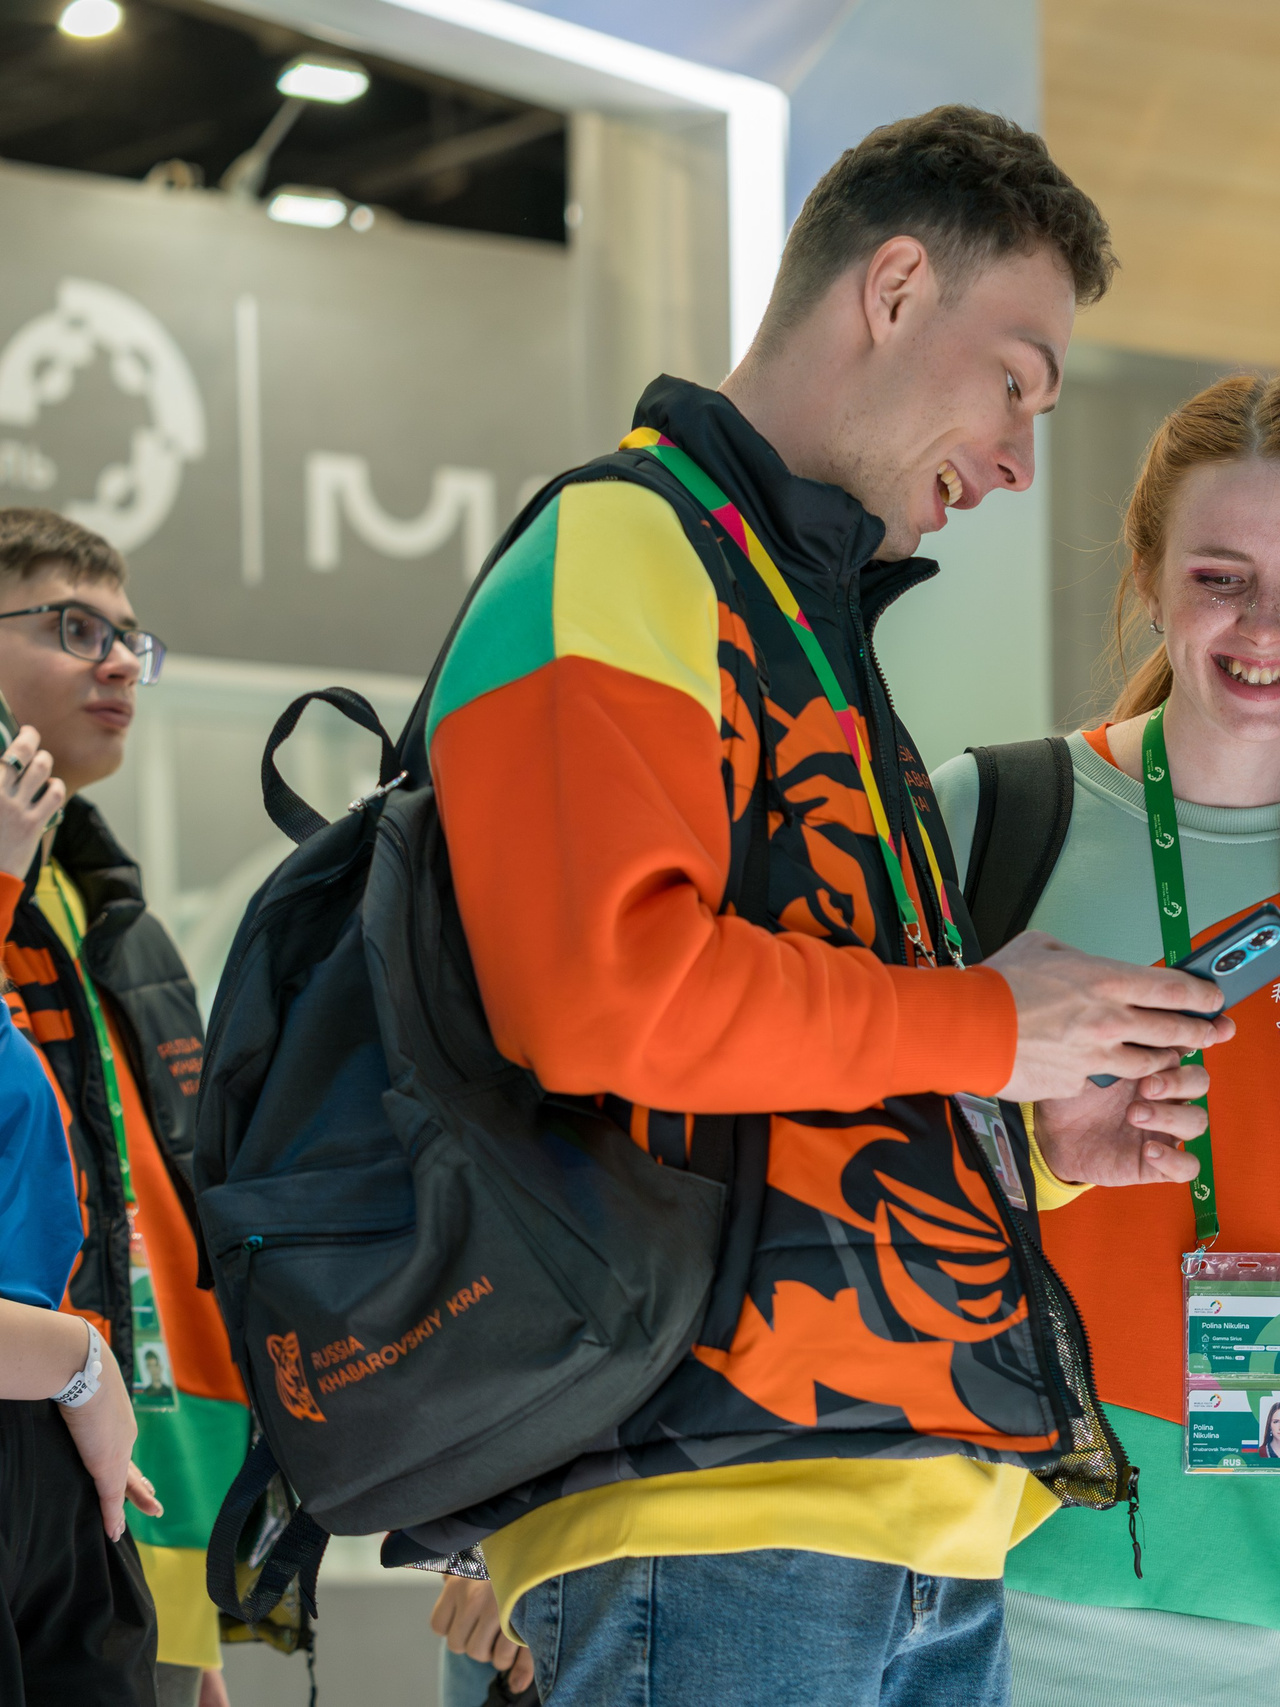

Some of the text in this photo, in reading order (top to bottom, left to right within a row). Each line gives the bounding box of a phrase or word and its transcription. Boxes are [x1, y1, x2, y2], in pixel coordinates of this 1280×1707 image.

[310, 1335, 366, 1371] RUSSIA
[317, 1275, 494, 1395] KHABAROVSKIY KRAI
[1223, 1459, 1241, 1467] RUS
